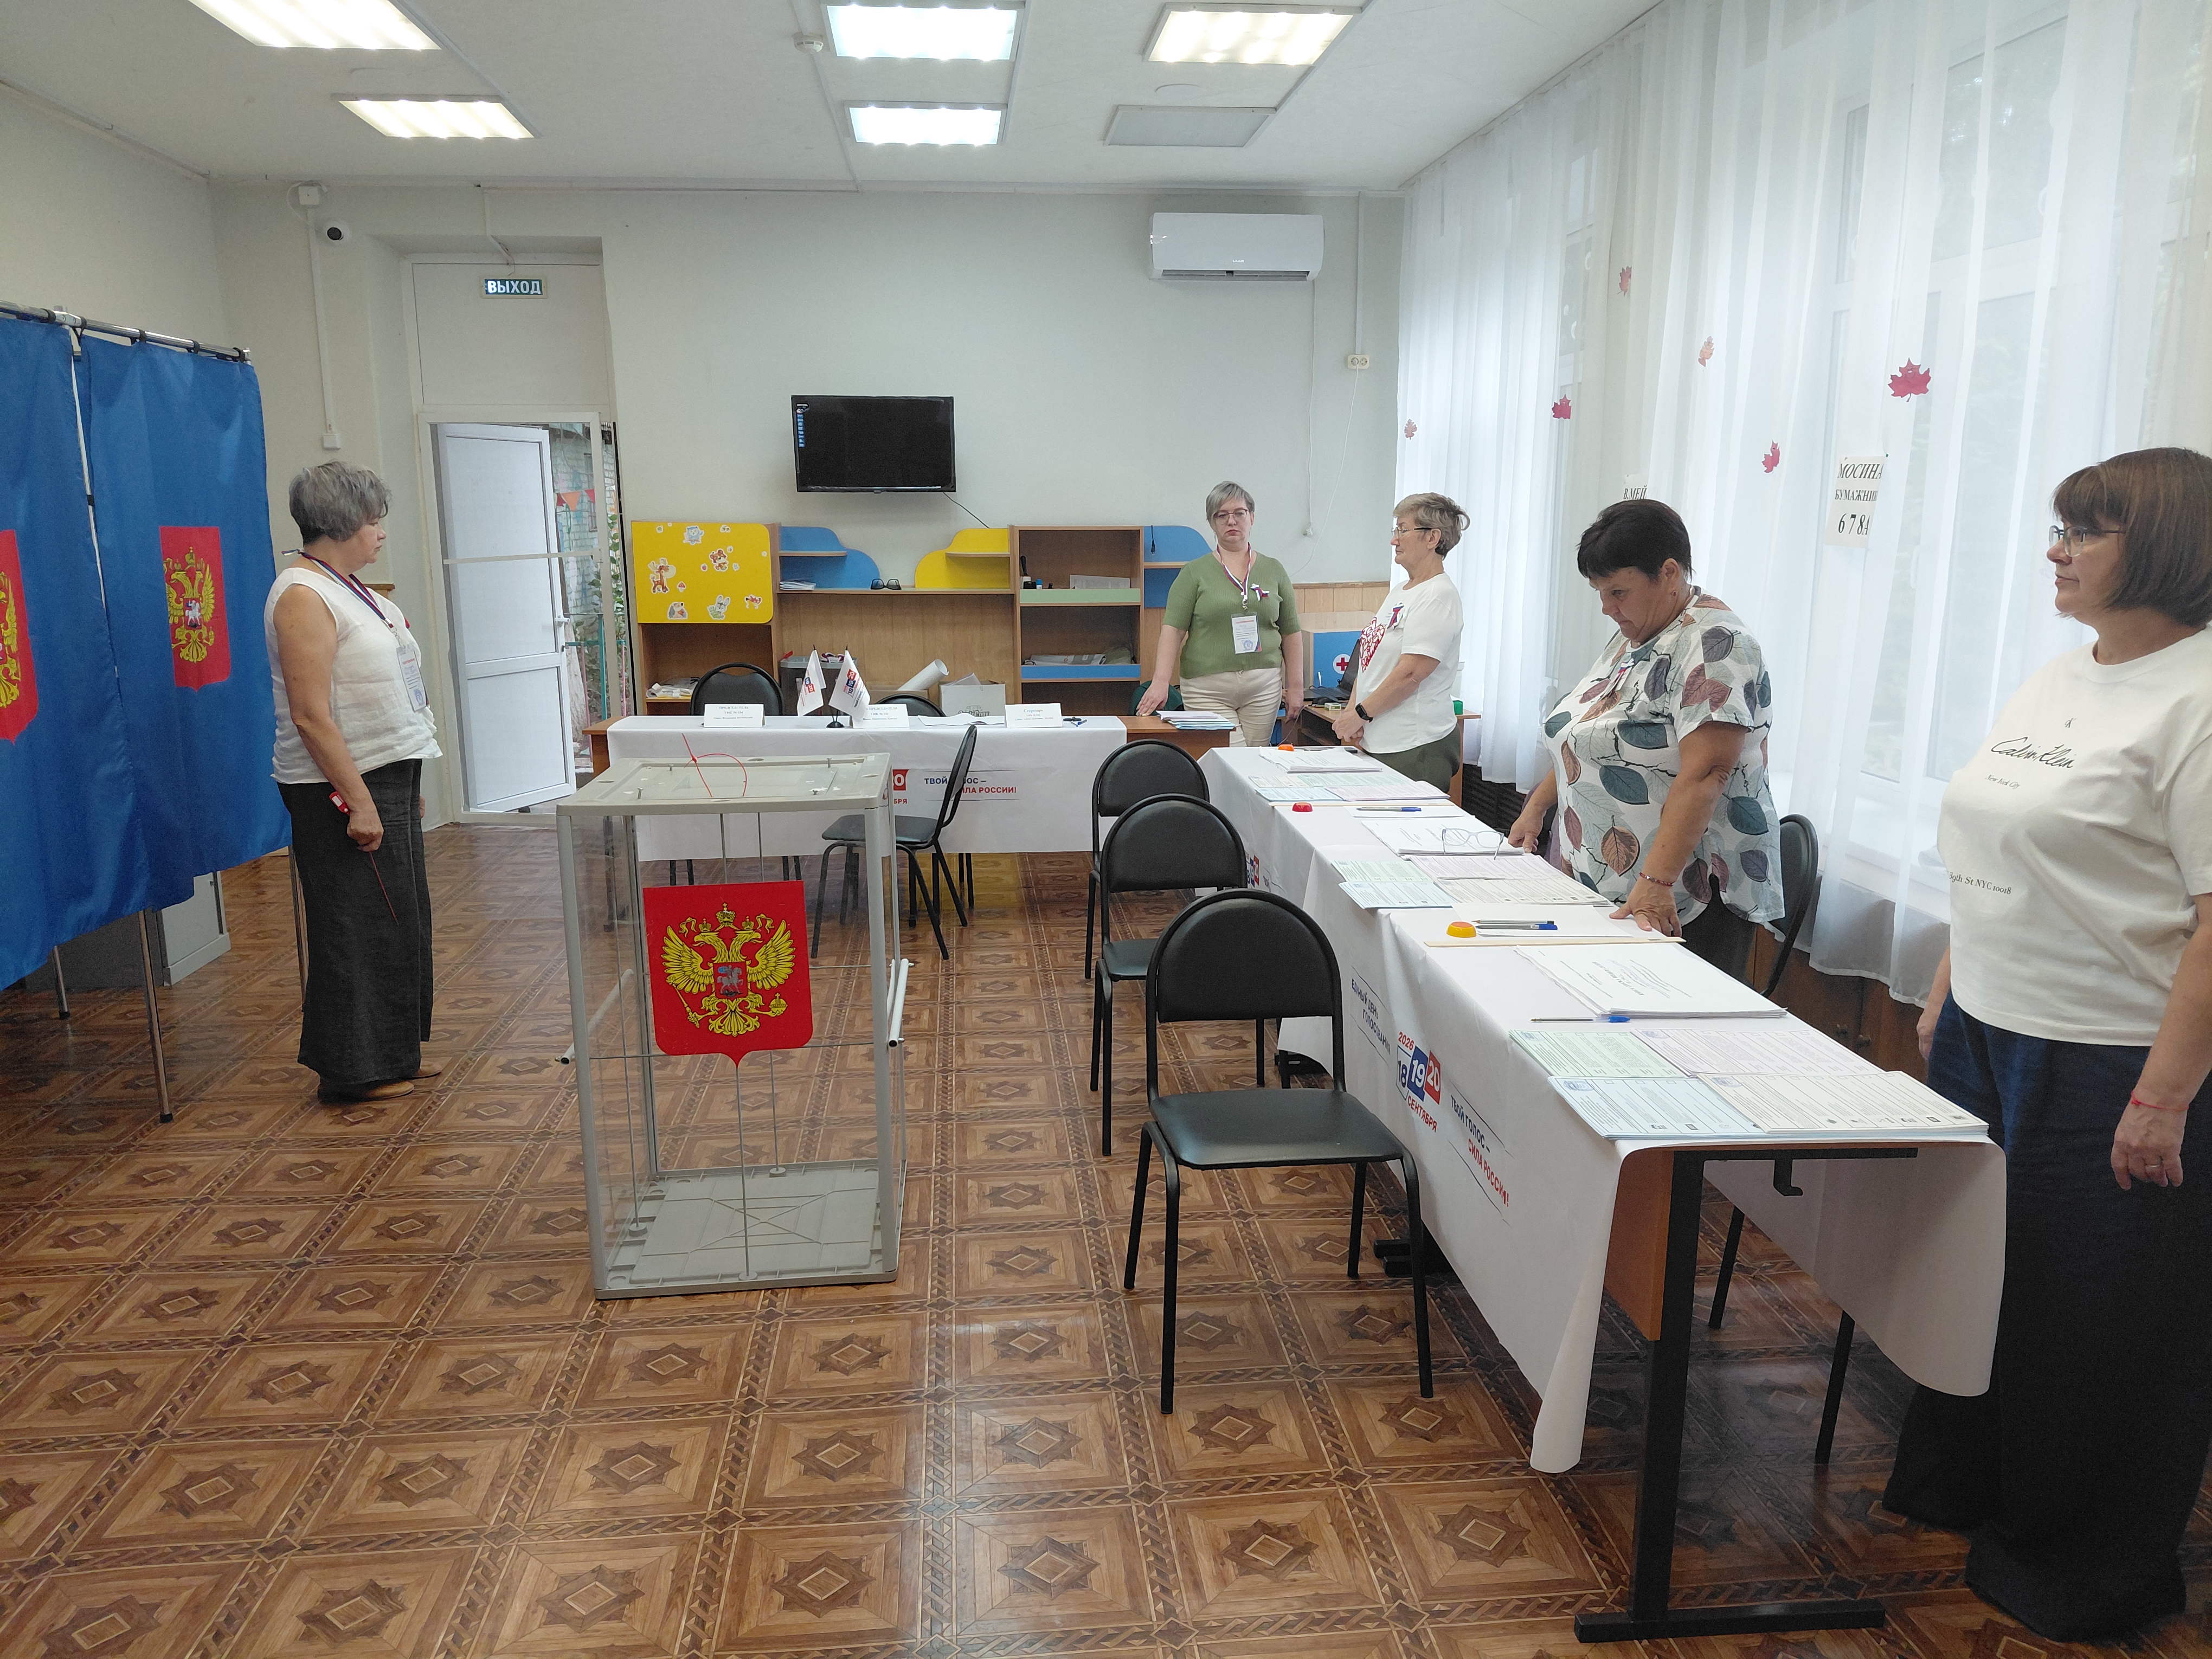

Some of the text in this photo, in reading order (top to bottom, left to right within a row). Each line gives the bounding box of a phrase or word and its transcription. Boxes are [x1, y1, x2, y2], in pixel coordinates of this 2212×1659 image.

[487, 280, 541, 294] ВЫХОД
[1991, 737, 2076, 768] Calvin Klein
[893, 774, 904, 786] 0
[1964, 876, 1973, 885] St
[1975, 879, 1992, 890] NYC
[1992, 886, 2012, 895] 10018
[1368, 999, 1378, 1019] ДЕНЬ
[1398, 1031, 1414, 1051] 2026
[1398, 1059, 1440, 1092] 18 19 20
[1407, 1095, 1437, 1133] СЕНТЯБРЯ
[1450, 1094, 1464, 1124] ТВОЙ
[1465, 1114, 1485, 1149] ГОЛОС
[1468, 1138, 1509, 1207] СИЛА РОССИИ!
